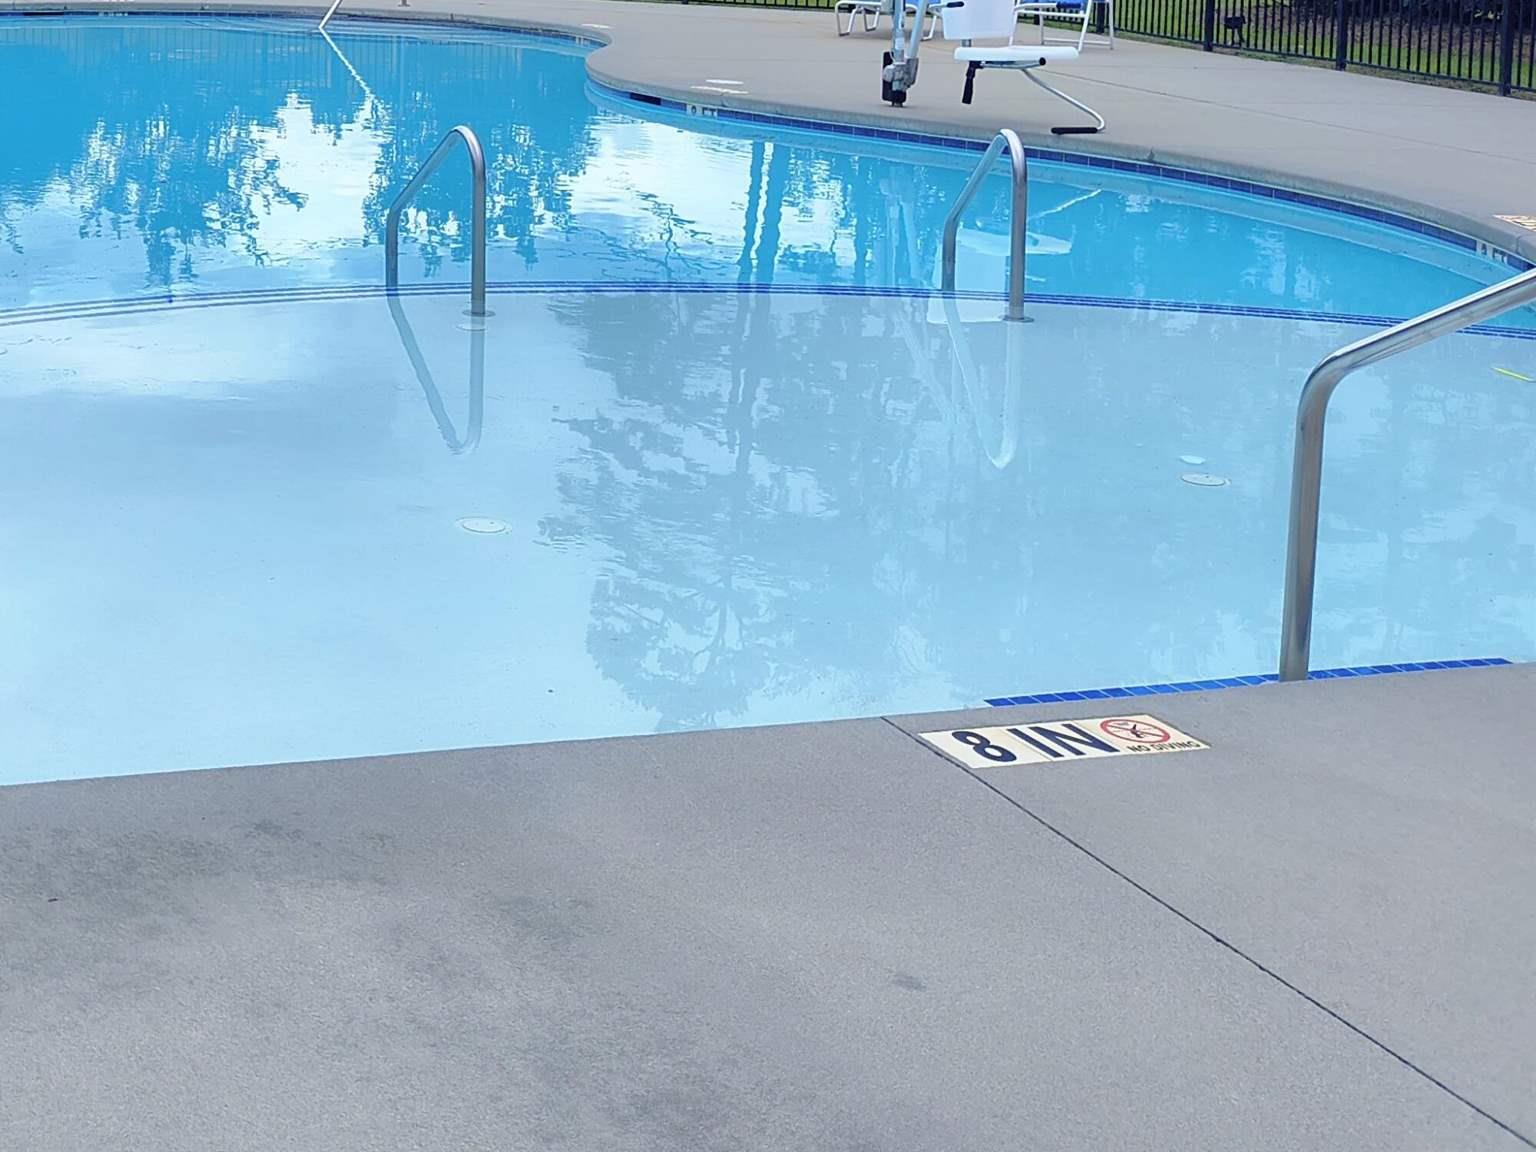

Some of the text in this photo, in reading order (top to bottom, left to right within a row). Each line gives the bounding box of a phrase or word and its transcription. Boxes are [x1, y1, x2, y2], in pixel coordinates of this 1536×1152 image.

[951, 723, 1121, 762] 8 IN
[1150, 741, 1201, 751] DIVING
